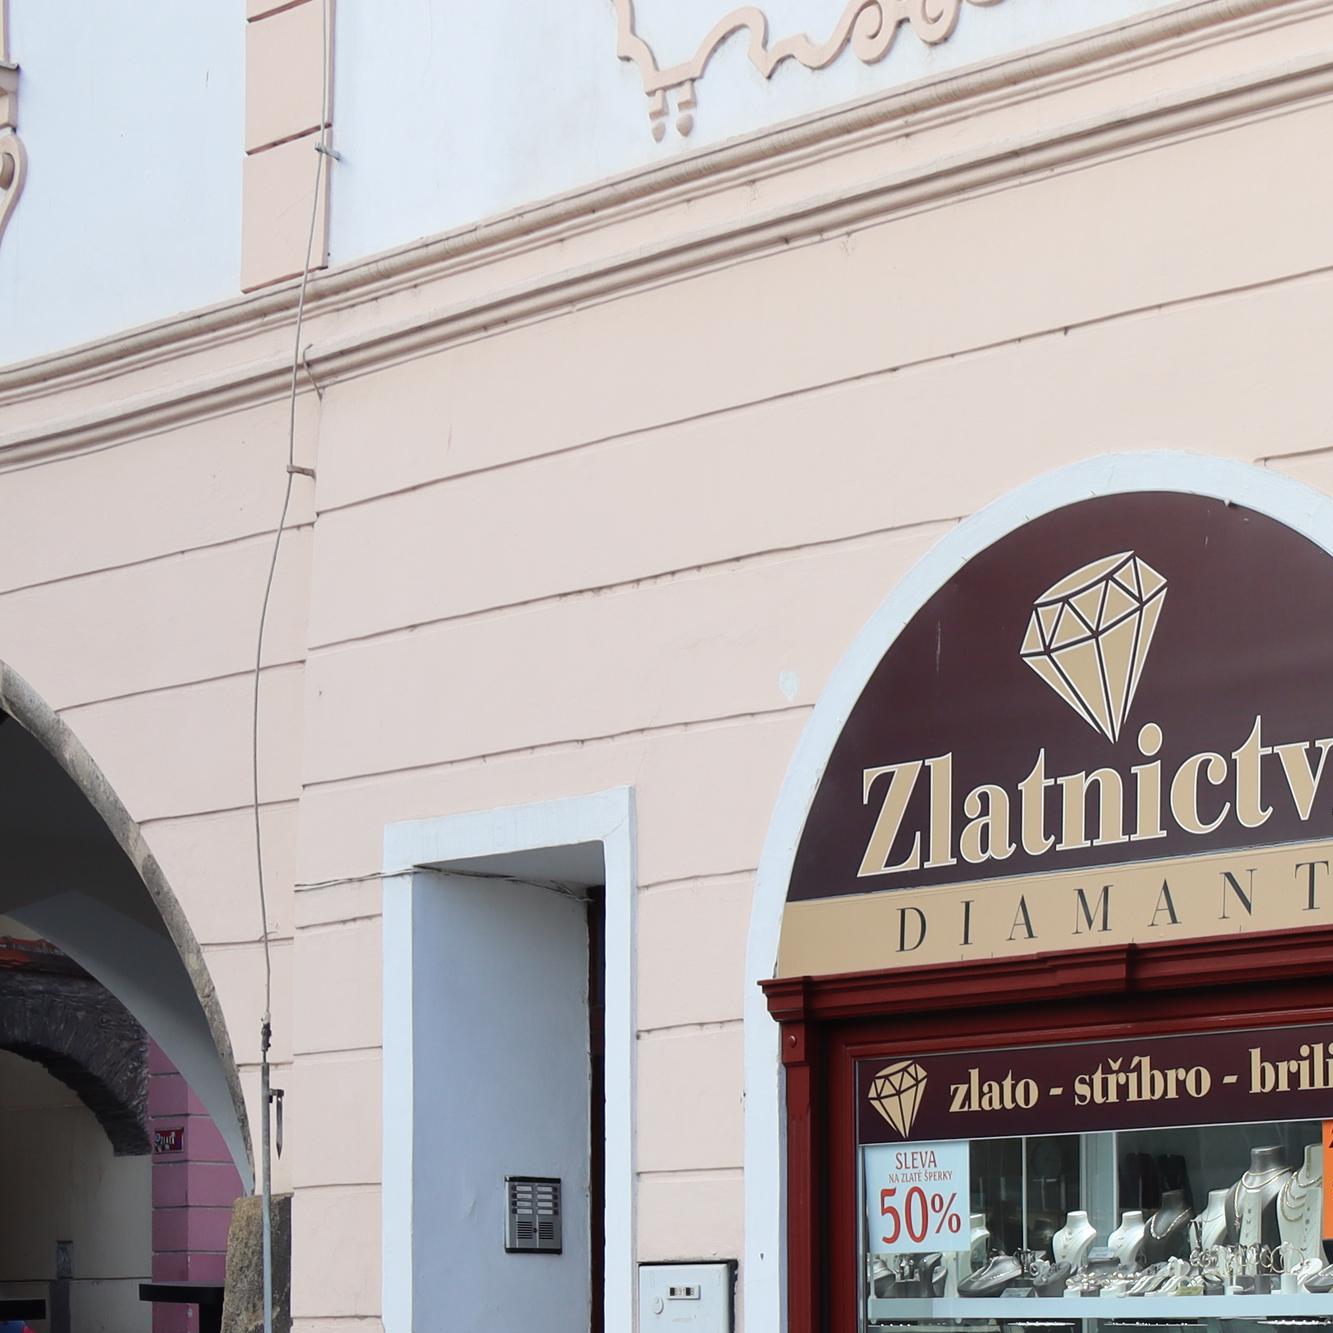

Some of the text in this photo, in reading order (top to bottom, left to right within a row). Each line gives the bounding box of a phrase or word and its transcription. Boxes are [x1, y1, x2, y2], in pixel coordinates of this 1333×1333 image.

[894, 860, 1331, 954] DIAMANT
[949, 1067, 1040, 1114] zlato
[1073, 1055, 1211, 1107] stříbro
[888, 1170, 953, 1184] NA ZLATÉ ŠPERKY
[895, 1149, 938, 1171] SLEVA
[879, 1184, 962, 1246] 50%
